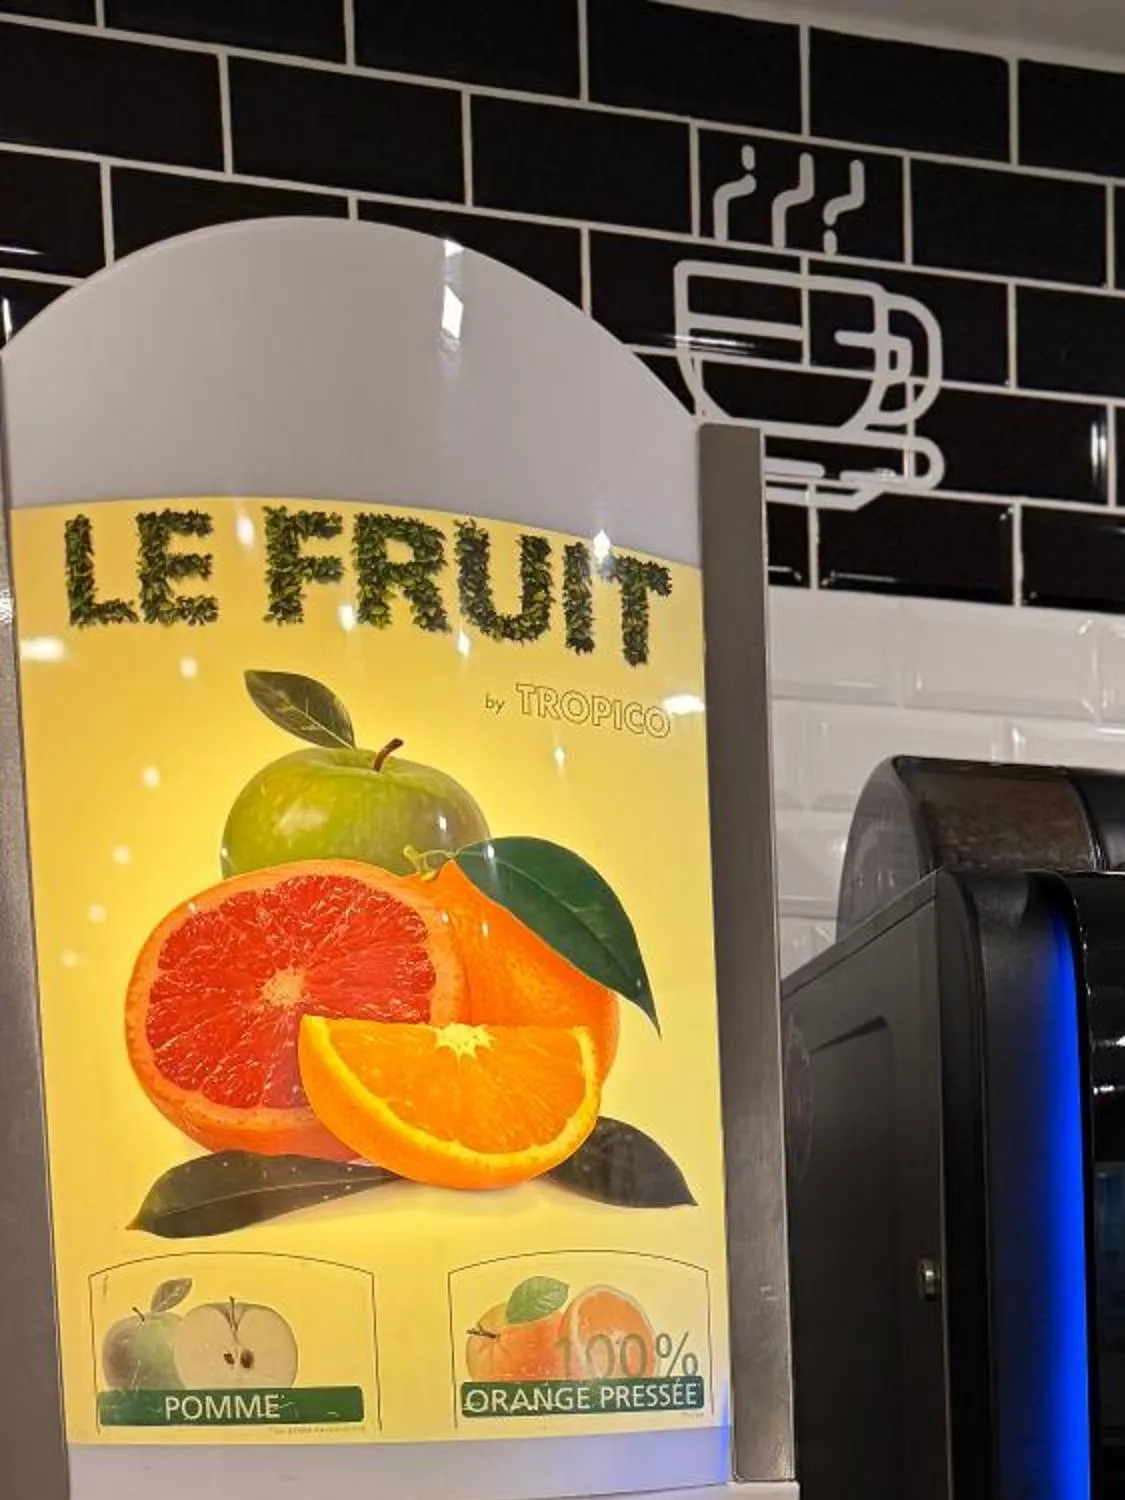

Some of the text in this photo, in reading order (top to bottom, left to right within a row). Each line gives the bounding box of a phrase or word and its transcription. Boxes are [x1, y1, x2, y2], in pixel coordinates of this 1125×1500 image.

[64, 505, 673, 668] LE FRUIT
[485, 683, 671, 739] by TROPICO
[554, 1331, 699, 1380] 100%
[165, 1393, 281, 1420] POMME
[464, 1377, 697, 1413] ORANGE PRESSÉE
